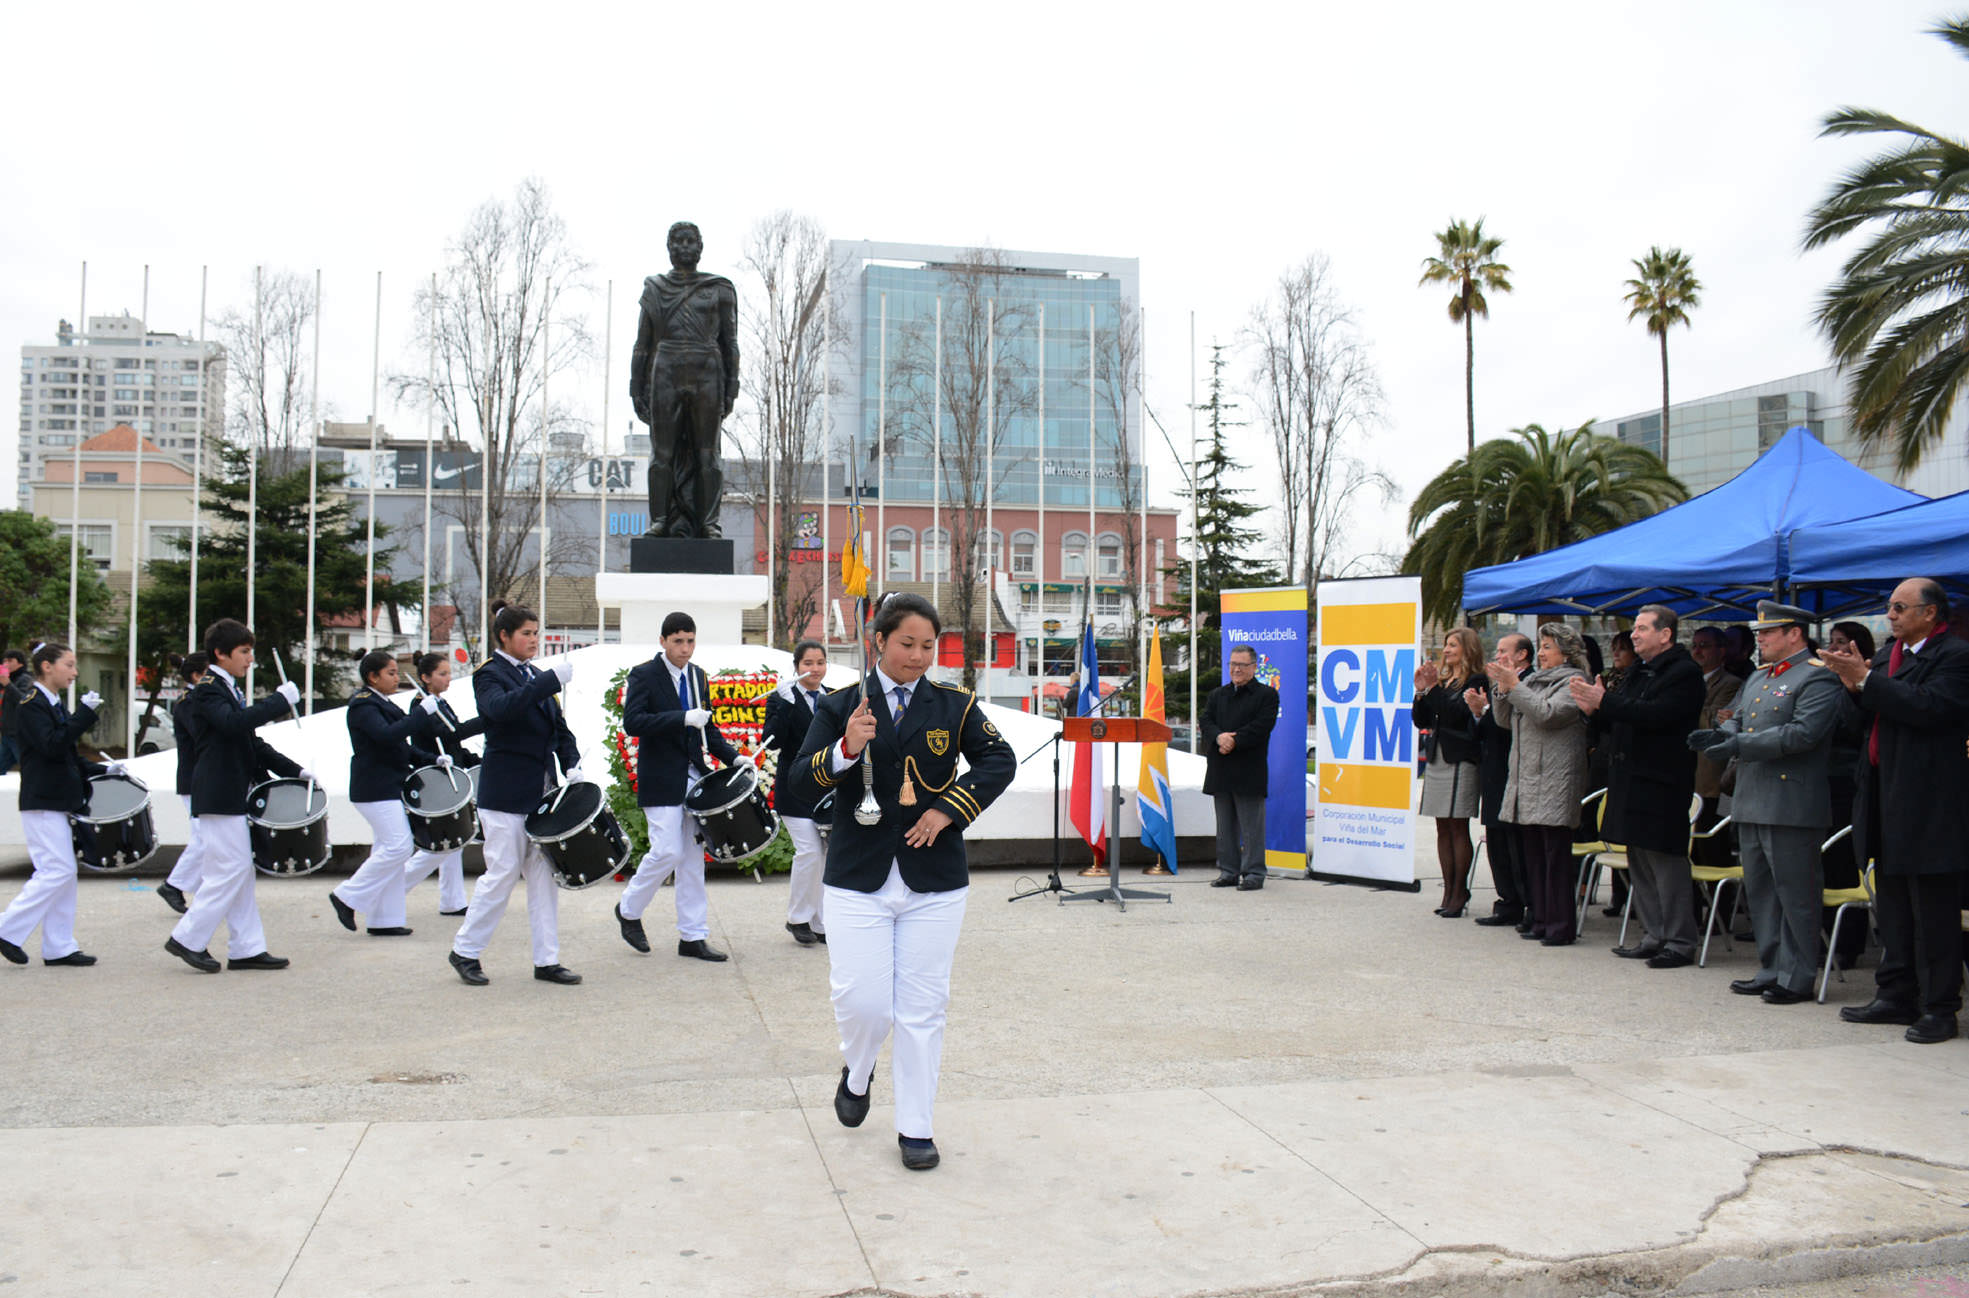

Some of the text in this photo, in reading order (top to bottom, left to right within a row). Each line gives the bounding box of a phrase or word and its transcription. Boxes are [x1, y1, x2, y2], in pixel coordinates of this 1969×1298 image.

[589, 460, 635, 488] CAT
[1321, 649, 1415, 704] CM
[712, 705, 767, 724] GINS
[1322, 706, 1412, 763] VM
[1368, 813, 1405, 824] Municipal
[1357, 825, 1369, 834] del
[1371, 826, 1386, 836] Mar
[1383, 841, 1405, 849] Social
